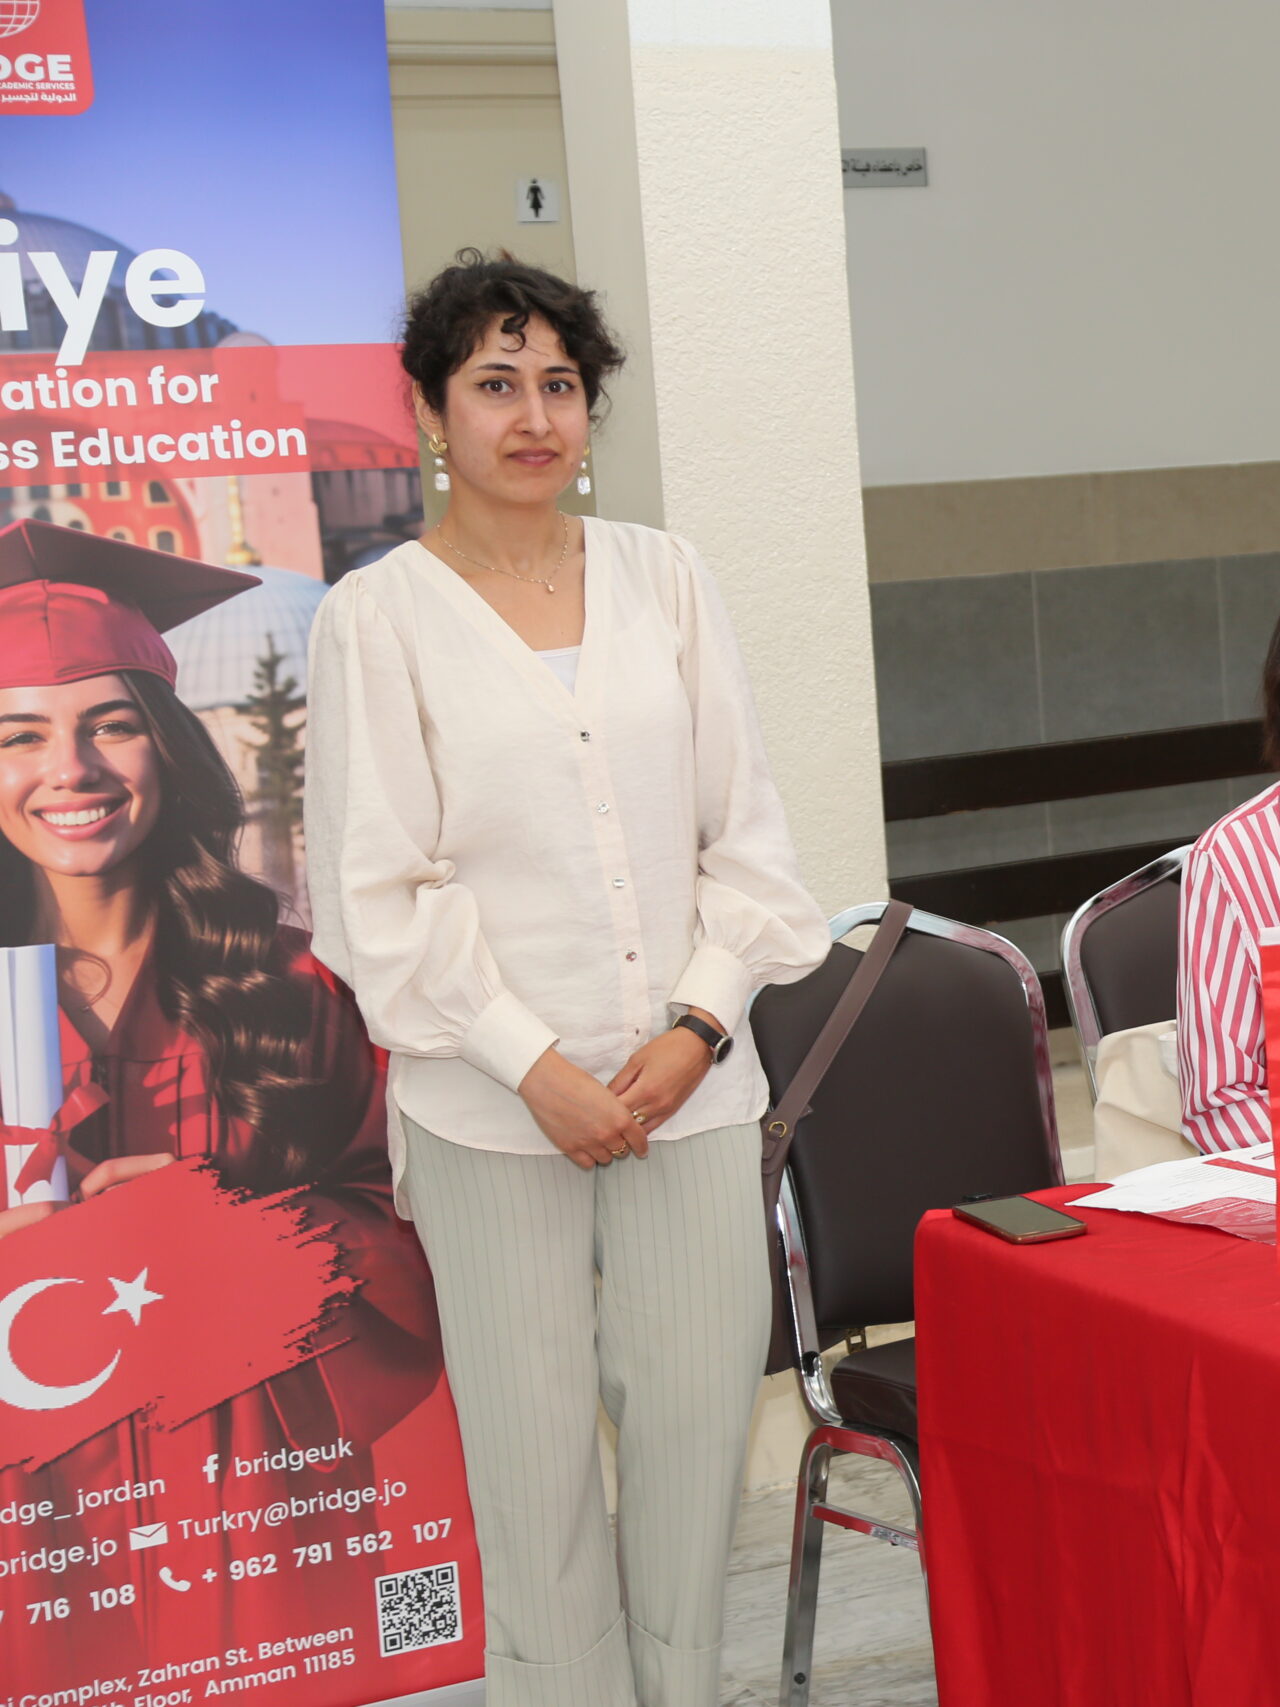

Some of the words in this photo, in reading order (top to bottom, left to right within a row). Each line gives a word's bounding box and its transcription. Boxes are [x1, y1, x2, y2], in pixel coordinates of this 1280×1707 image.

[35, 82, 76, 90] SERVICES
[0, 218, 206, 366] iye
[1, 367, 137, 411] ation
[147, 366, 219, 405] for
[51, 420, 308, 468] Education
[234, 1438, 354, 1478] bridgeuk
[178, 1479, 408, 1540] Turkry@bridge.jo
[229, 1553, 278, 1581] 962
[293, 1541, 333, 1568] 791
[346, 1530, 394, 1557] 562
[413, 1518, 453, 1544] 107
[26, 1597, 71, 1625] 716
[89, 1584, 136, 1612] 108
[19, 1677, 133, 1707] Complex,
[137, 1655, 220, 1688] Zahran
[224, 1648, 253, 1668] St.
[258, 1624, 355, 1661] Between
[204, 1662, 297, 1698] Amman
[303, 1648, 356, 1675] 11185
